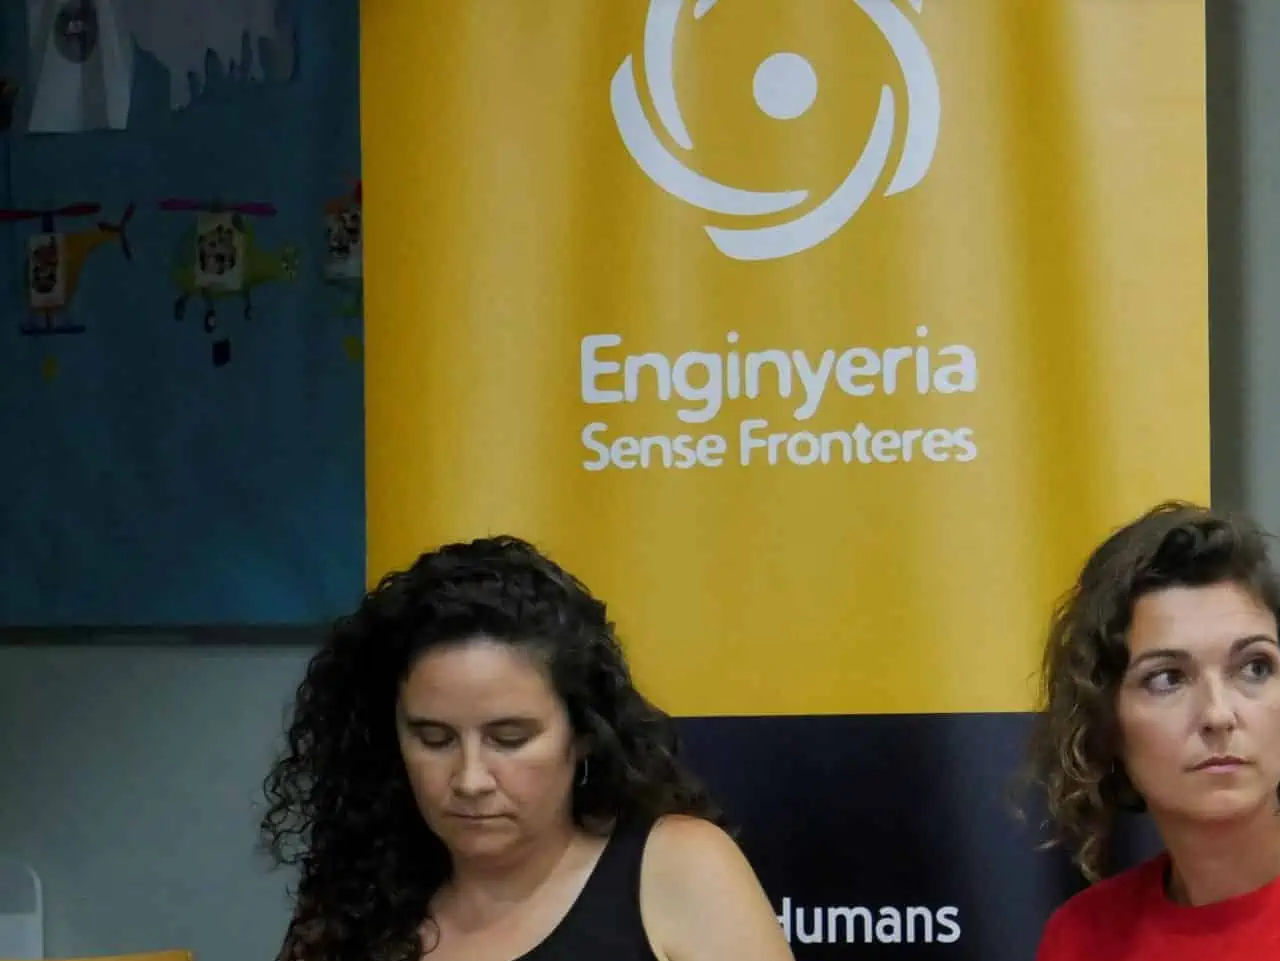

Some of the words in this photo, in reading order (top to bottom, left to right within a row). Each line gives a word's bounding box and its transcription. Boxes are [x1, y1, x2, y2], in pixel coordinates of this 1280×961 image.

[580, 325, 978, 424] Enginyeria
[581, 421, 728, 471] Sense
[739, 418, 977, 467] Fronteres
